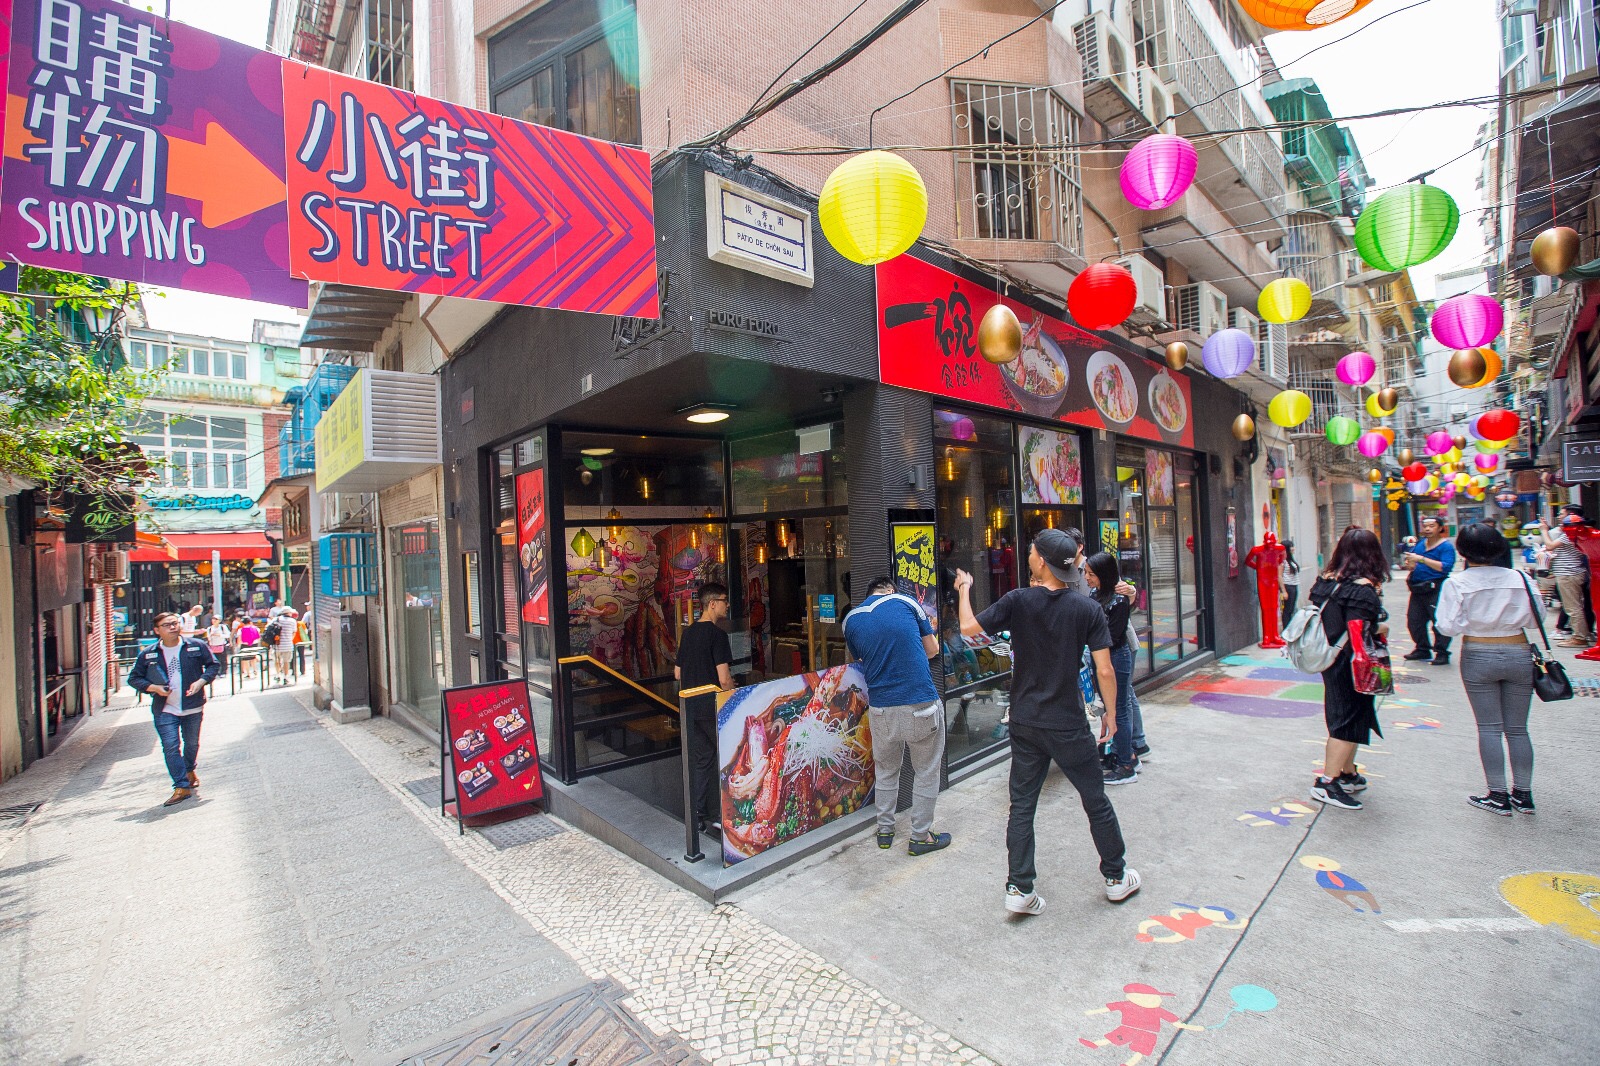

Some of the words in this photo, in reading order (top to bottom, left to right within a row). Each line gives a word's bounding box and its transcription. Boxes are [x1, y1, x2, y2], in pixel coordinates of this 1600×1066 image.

[28, 0, 164, 205] 購物
[300, 94, 490, 210] 小街
[17, 197, 205, 265] SHOPPING
[304, 194, 487, 276] STREET
[755, 238, 763, 247] DE
[708, 308, 744, 329] FURU
[747, 316, 780, 335] FURU
